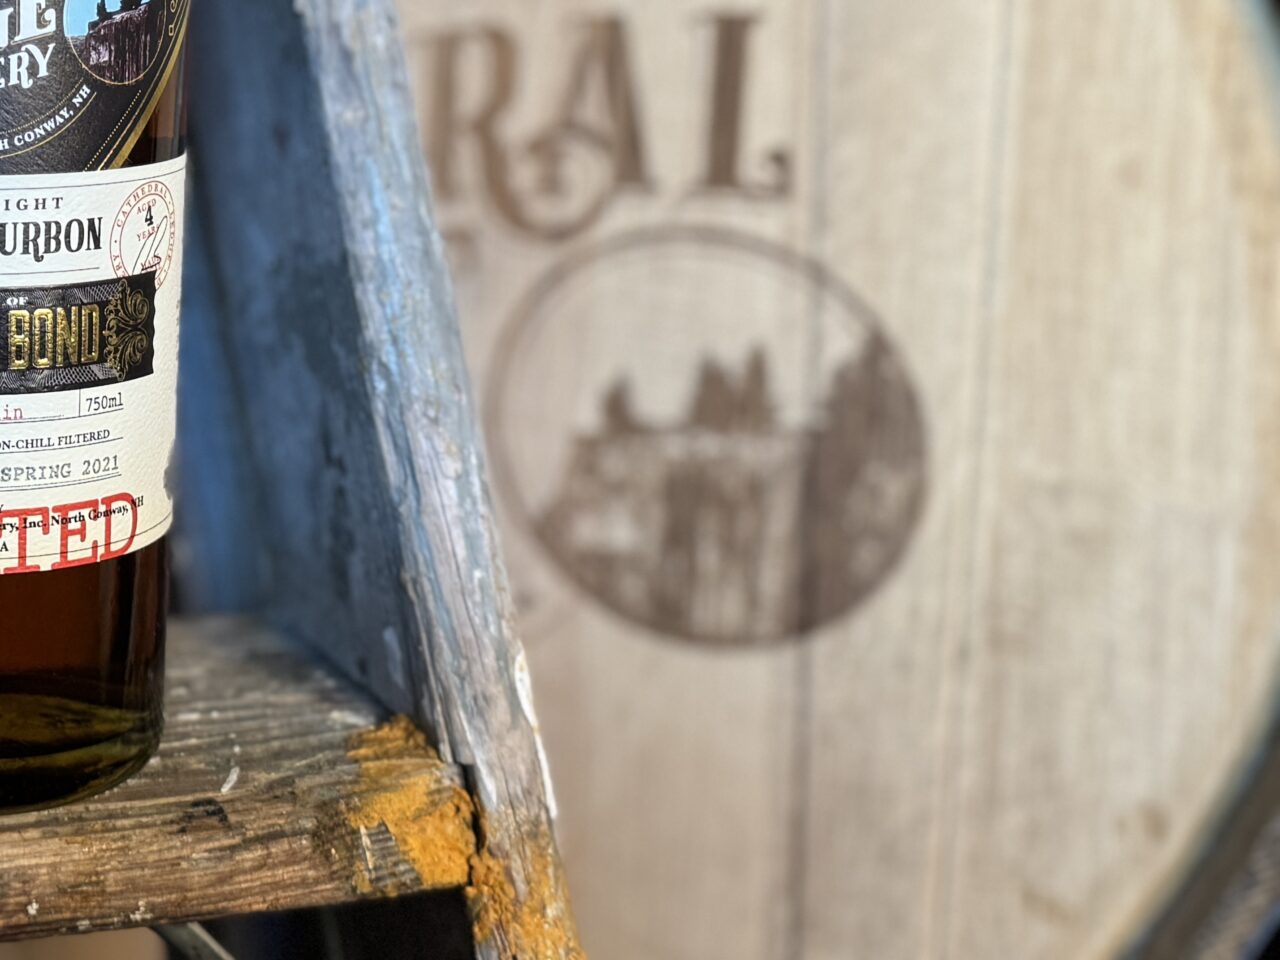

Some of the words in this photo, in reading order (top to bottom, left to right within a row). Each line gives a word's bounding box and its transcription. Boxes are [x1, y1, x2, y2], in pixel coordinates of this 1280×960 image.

[14, 107, 74, 146] CONWAY,
[71, 84, 91, 107] NH
[116, 183, 167, 228] CATHEDRAL
[137, 198, 157, 215] AGED
[144, 205, 154, 227] 4
[5, 296, 29, 306] OF
[8, 303, 100, 370] BOND
[85, 392, 123, 413] 750ml
[57, 428, 110, 447] FILTERED
[0, 463, 72, 483] SPRING
[81, 454, 119, 477] 2021
[50, 510, 85, 527] North
[87, 503, 129, 522] Conway,
